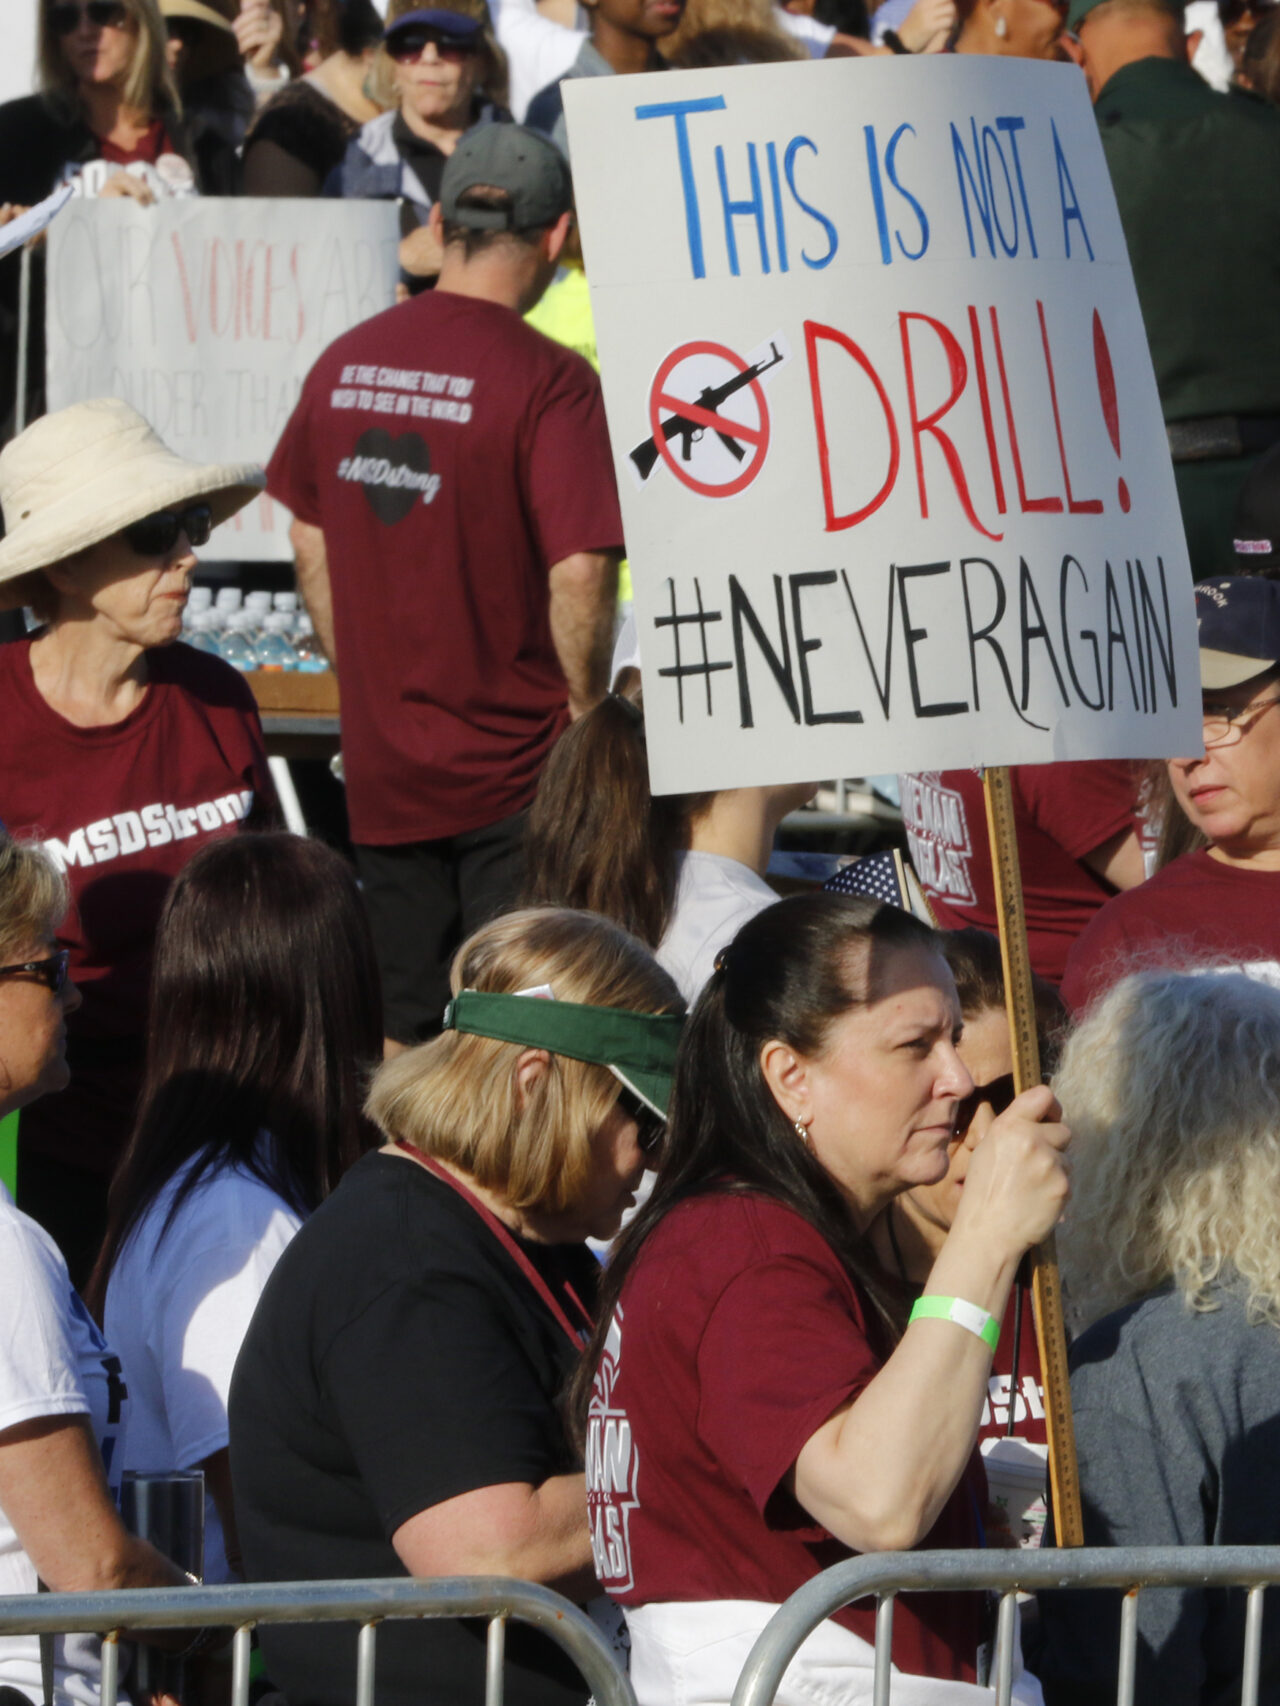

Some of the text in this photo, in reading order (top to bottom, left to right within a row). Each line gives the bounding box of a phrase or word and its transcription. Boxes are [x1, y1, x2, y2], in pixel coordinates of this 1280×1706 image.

[635, 94, 1095, 280] THIS IS NOT A
[171, 230, 306, 345] VOICES
[355, 365, 378, 385] THE
[376, 367, 422, 391] CHANGE
[421, 372, 450, 394] THAT
[803, 300, 1132, 542] DRILL!
[654, 555, 1177, 731] #NEVERAGAIN
